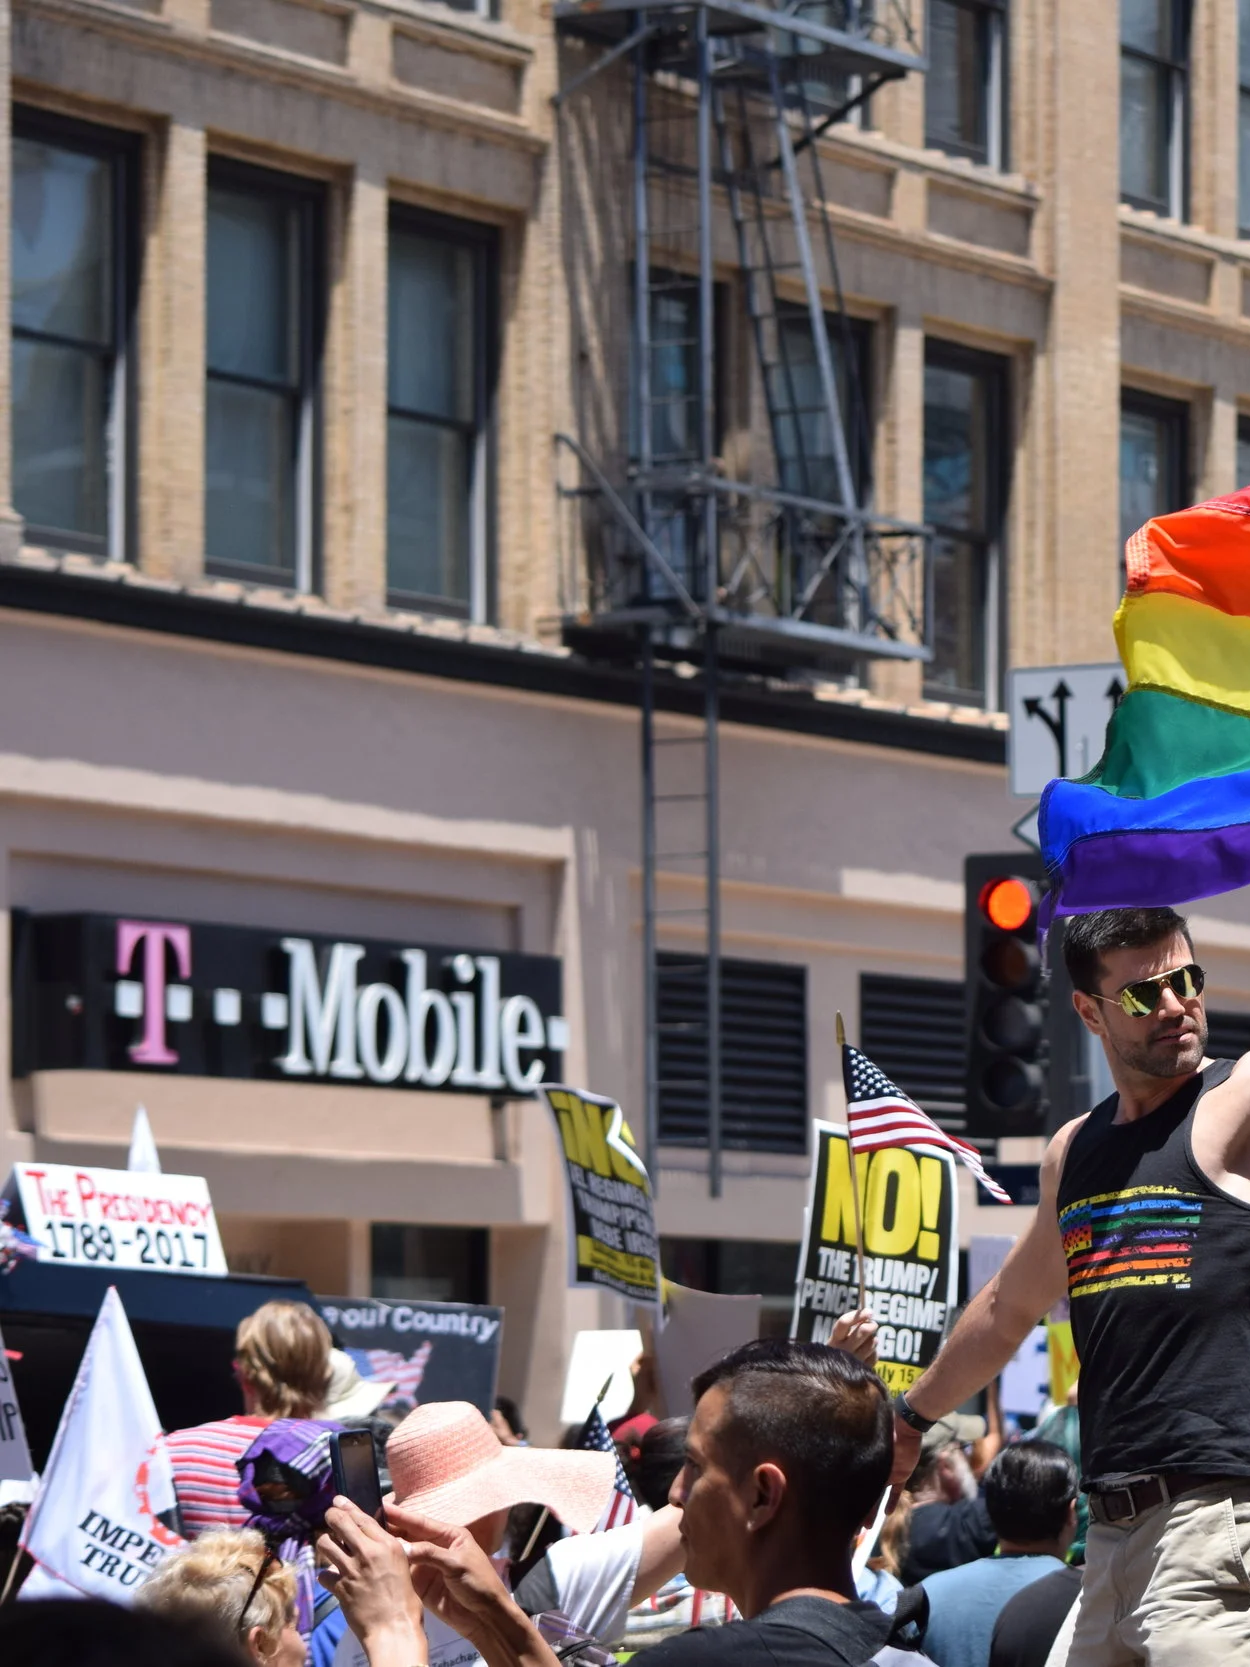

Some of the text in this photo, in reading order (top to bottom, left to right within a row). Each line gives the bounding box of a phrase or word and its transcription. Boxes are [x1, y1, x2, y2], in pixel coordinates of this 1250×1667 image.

[821, 1136, 942, 1261] NO!
[46, 1221, 208, 1268] 1789-2017
[818, 1246, 851, 1282] THE
[801, 1278, 858, 1315] PENCE
[391, 1306, 500, 1344] Country
[875, 1325, 923, 1362] GO!
[874, 1367, 915, 1383] uly 15
